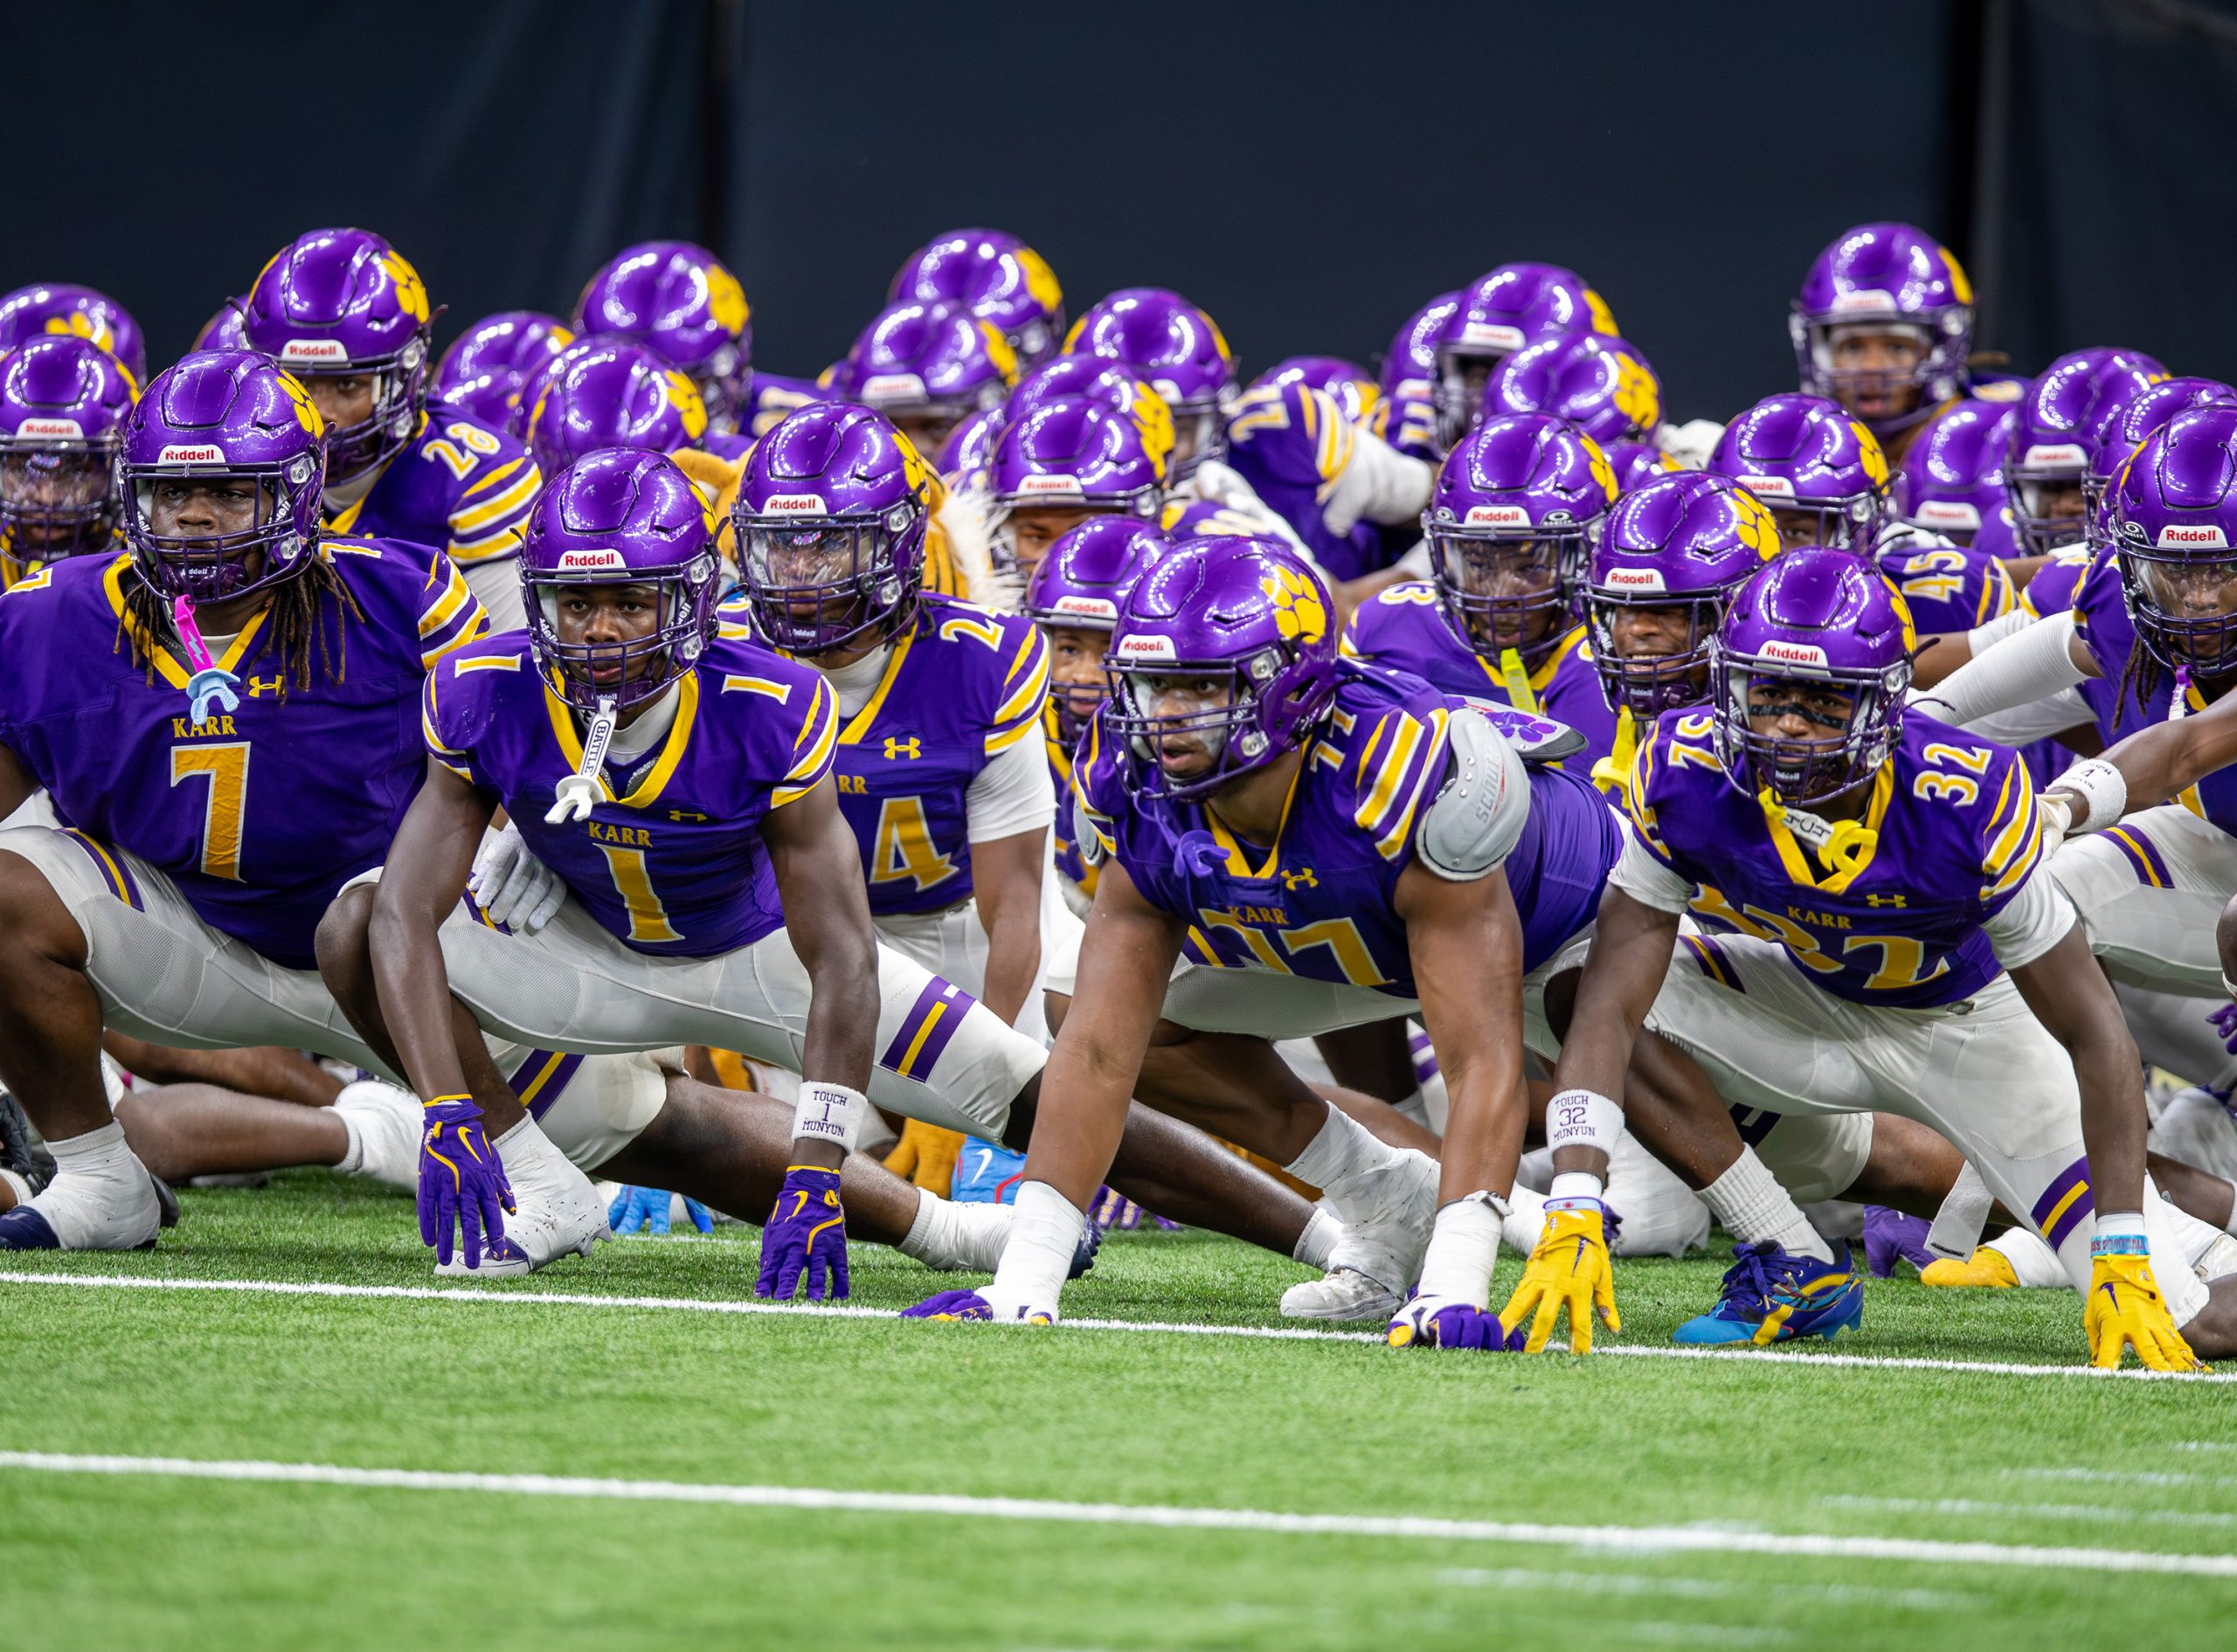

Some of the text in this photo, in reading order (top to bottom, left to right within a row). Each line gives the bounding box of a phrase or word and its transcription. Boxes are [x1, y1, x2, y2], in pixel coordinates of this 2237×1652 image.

[165, 449, 215, 461] Riddell
[421, 422, 502, 482] 28
[770, 498, 816, 510] Riddell
[1472, 510, 1520, 522] Riddell
[2166, 529, 2216, 542] Riddell
[564, 553, 614, 567] Riddell
[1610, 572, 1654, 584] Riddell
[1901, 550, 1968, 604] 45
[1124, 639, 1164, 652] Riddell
[1766, 646, 1818, 662] Riddell
[722, 674, 792, 705] 1
[172, 715, 238, 738] KARR
[585, 725, 607, 773] BATTLE
[1913, 743, 1993, 807] 32
[170, 741, 252, 883] 7
[588, 820, 652, 847] KARR
[594, 842, 685, 943] 1
[1786, 905, 1853, 930] KARR
[813, 1090, 848, 1107] TOUCH
[1555, 1095, 1589, 1109] TOUCH
[821, 1102, 830, 1123] 1
[1559, 1106, 1586, 1127] 32
[801, 1120, 845, 1137] MUNYUN
[1553, 1125, 1596, 1144] MUNYUN
